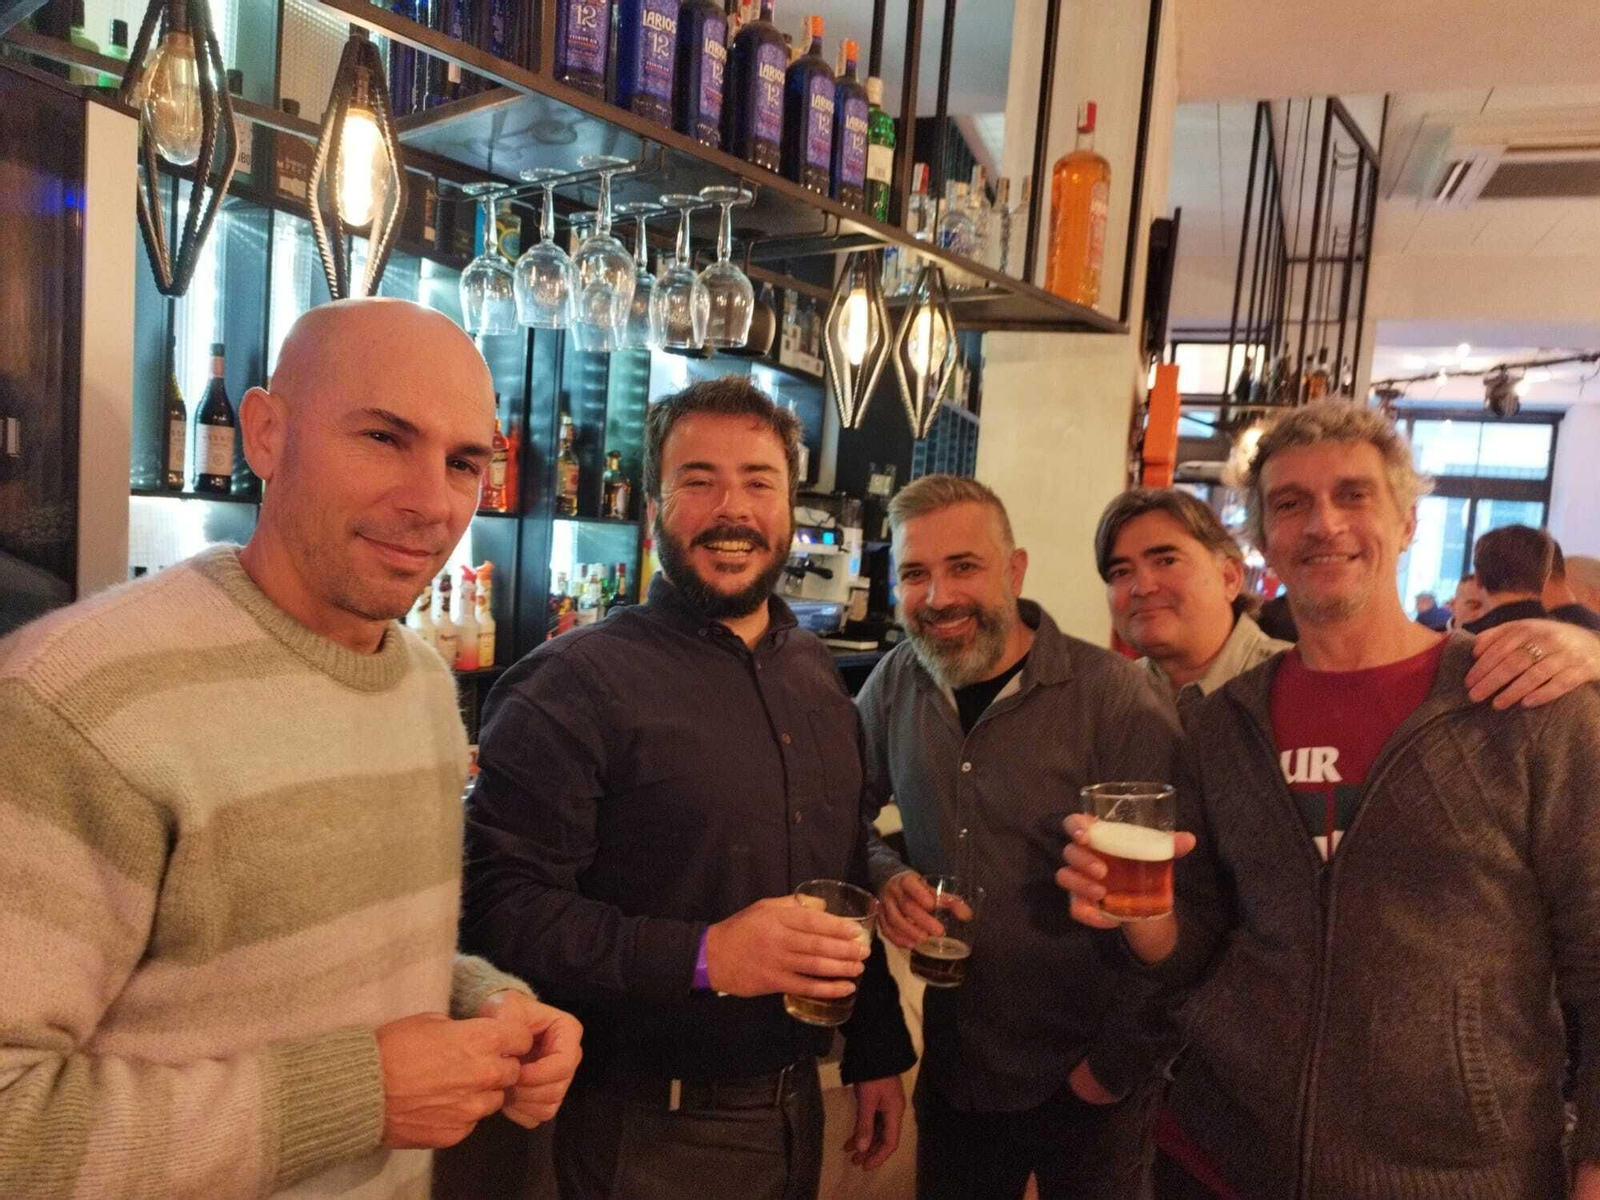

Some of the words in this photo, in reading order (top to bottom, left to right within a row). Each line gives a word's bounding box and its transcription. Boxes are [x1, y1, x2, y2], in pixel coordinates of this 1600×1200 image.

[571, 3, 597, 28] 12
[643, 9, 677, 34] LARIOS
[648, 31, 669, 57] 12
[764, 81, 780, 106] 12
[817, 112, 831, 134] 12
